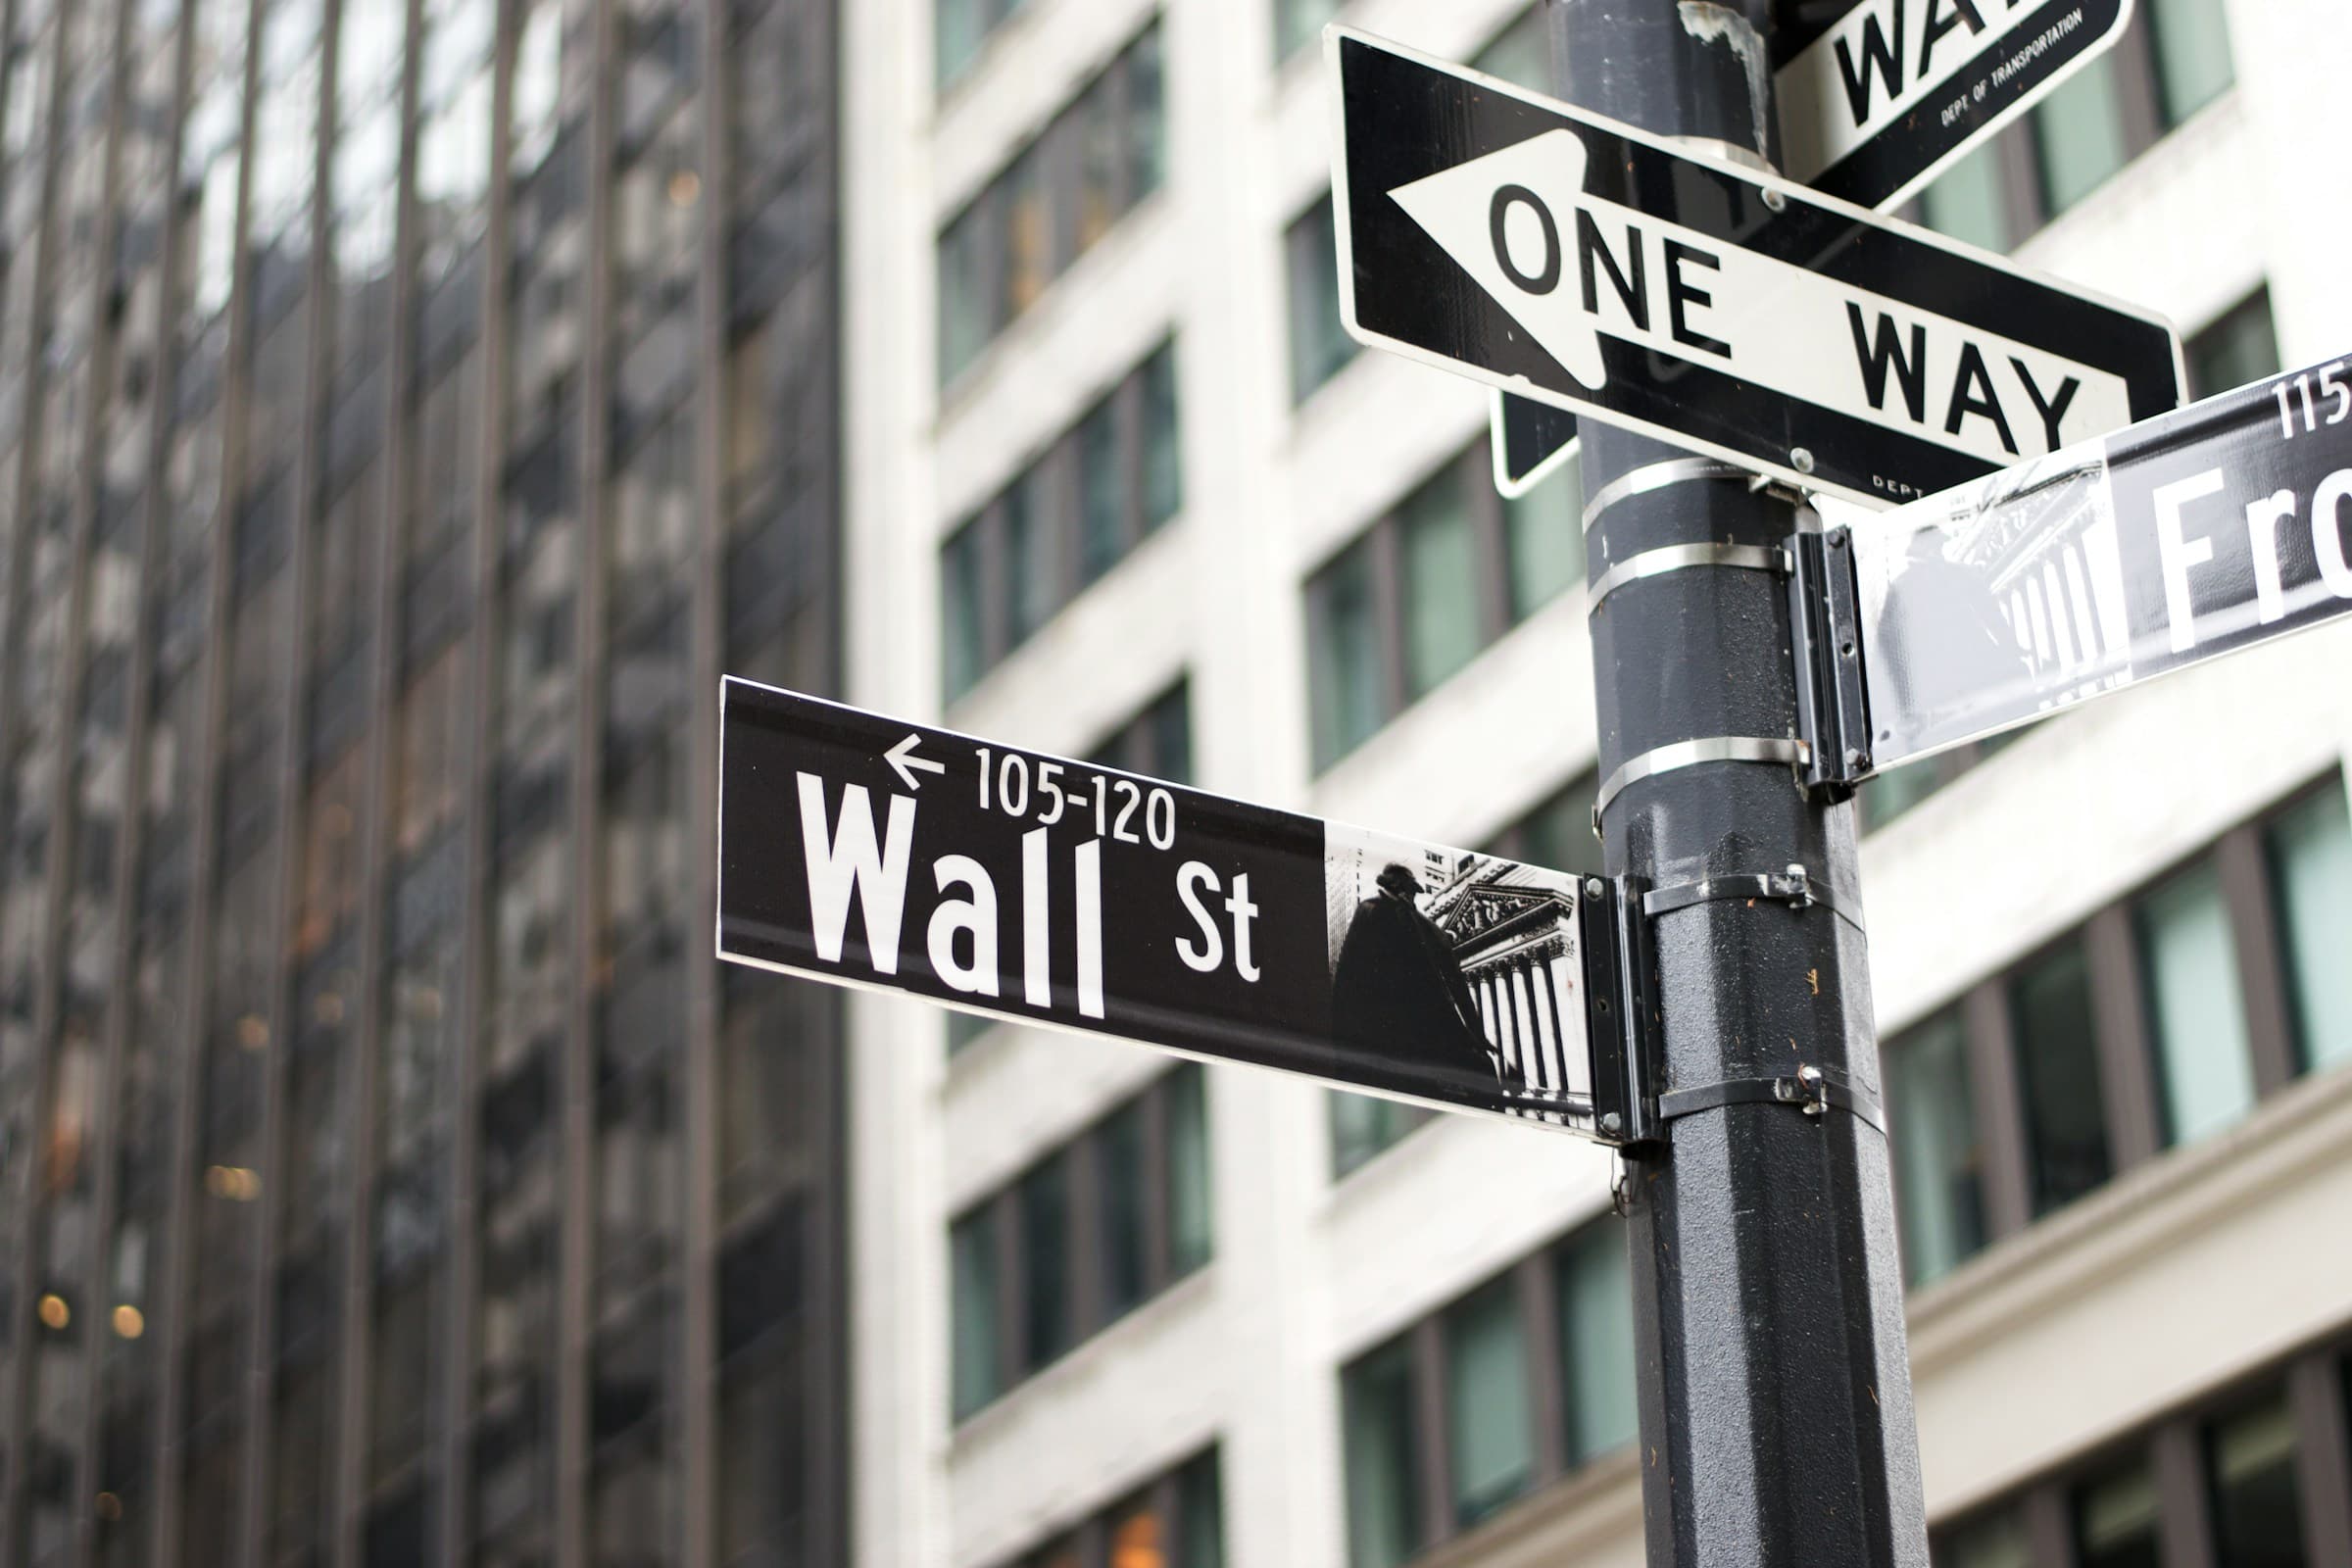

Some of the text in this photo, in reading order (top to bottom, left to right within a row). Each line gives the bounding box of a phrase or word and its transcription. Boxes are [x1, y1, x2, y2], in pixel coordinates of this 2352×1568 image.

[1833, 0, 2021, 128] WA
[1940, 7, 2083, 127] DEPT OF TRANSPORTATION
[1489, 183, 2081, 457] ONE WAY
[2272, 361, 2352, 440] 115
[1872, 474, 1923, 500] DEPT
[975, 748, 1176, 851] 105-120
[796, 770, 1261, 1020] Wall St
